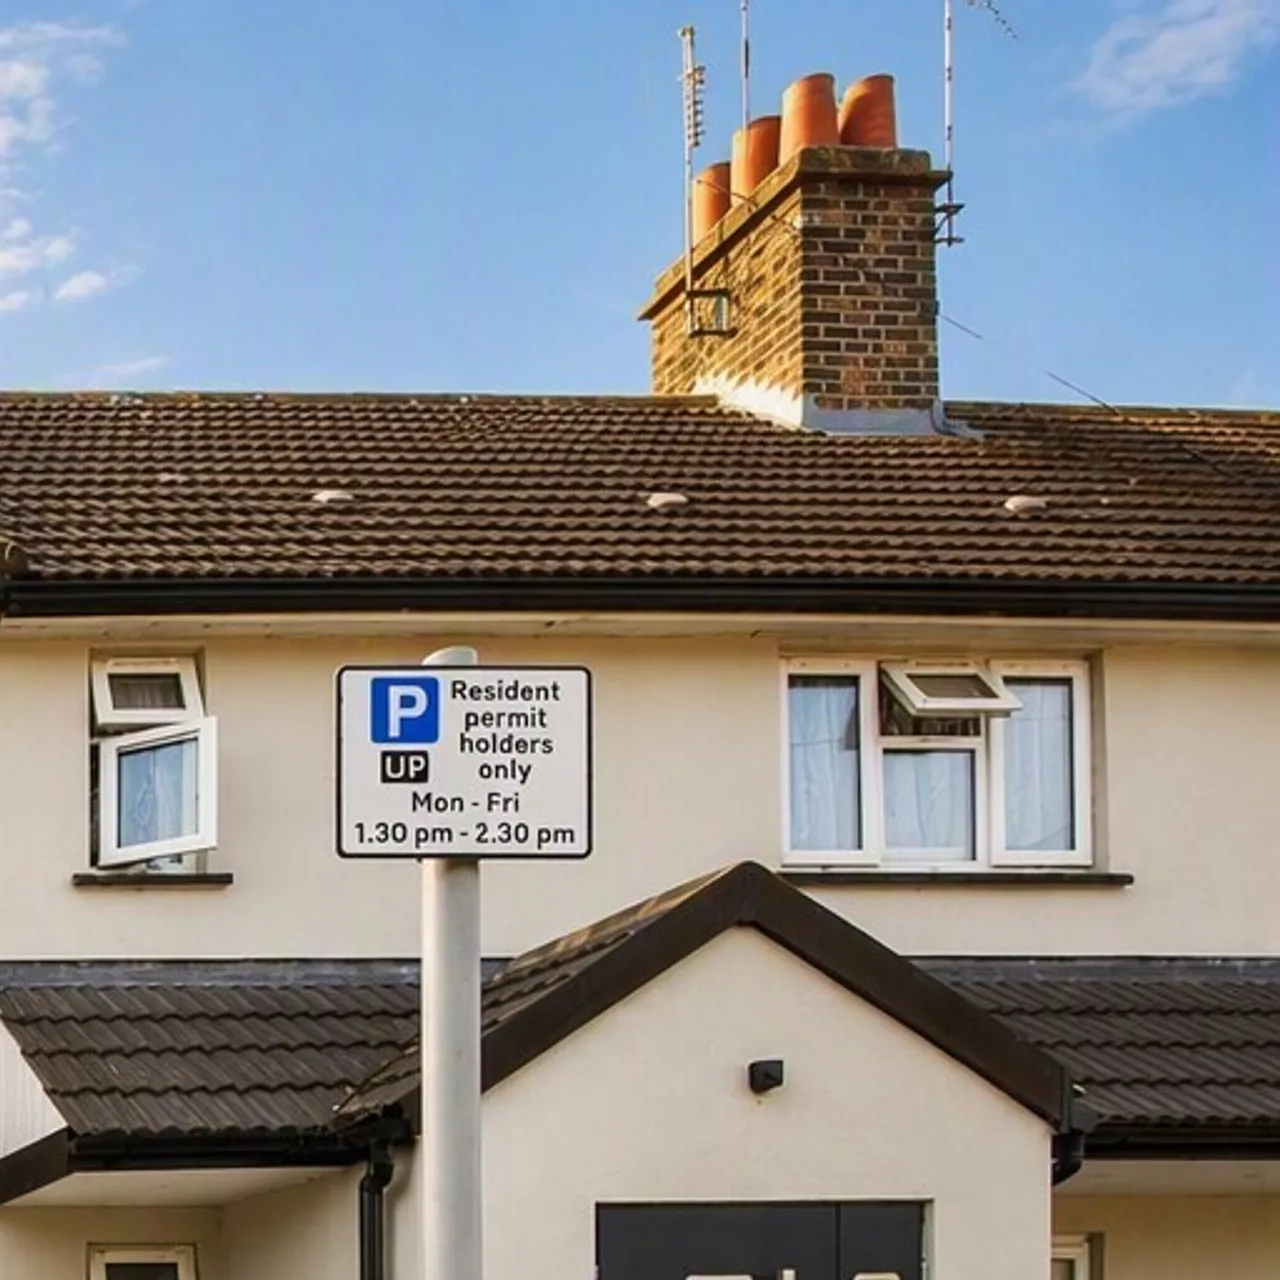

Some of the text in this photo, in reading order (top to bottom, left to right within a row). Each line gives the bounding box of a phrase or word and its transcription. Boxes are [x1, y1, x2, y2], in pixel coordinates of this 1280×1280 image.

[451, 680, 560, 701] Resident
[388, 685, 429, 738] P
[464, 707, 547, 732] permit
[459, 733, 554, 754] holders
[385, 755, 426, 779] UP
[478, 759, 532, 784] only
[412, 792, 464, 813] Mon
[487, 792, 520, 813] Fri
[355, 822, 407, 844] 1.30
[415, 827, 453, 849] pm
[475, 822, 529, 844] 2.30
[537, 827, 575, 850] pm
